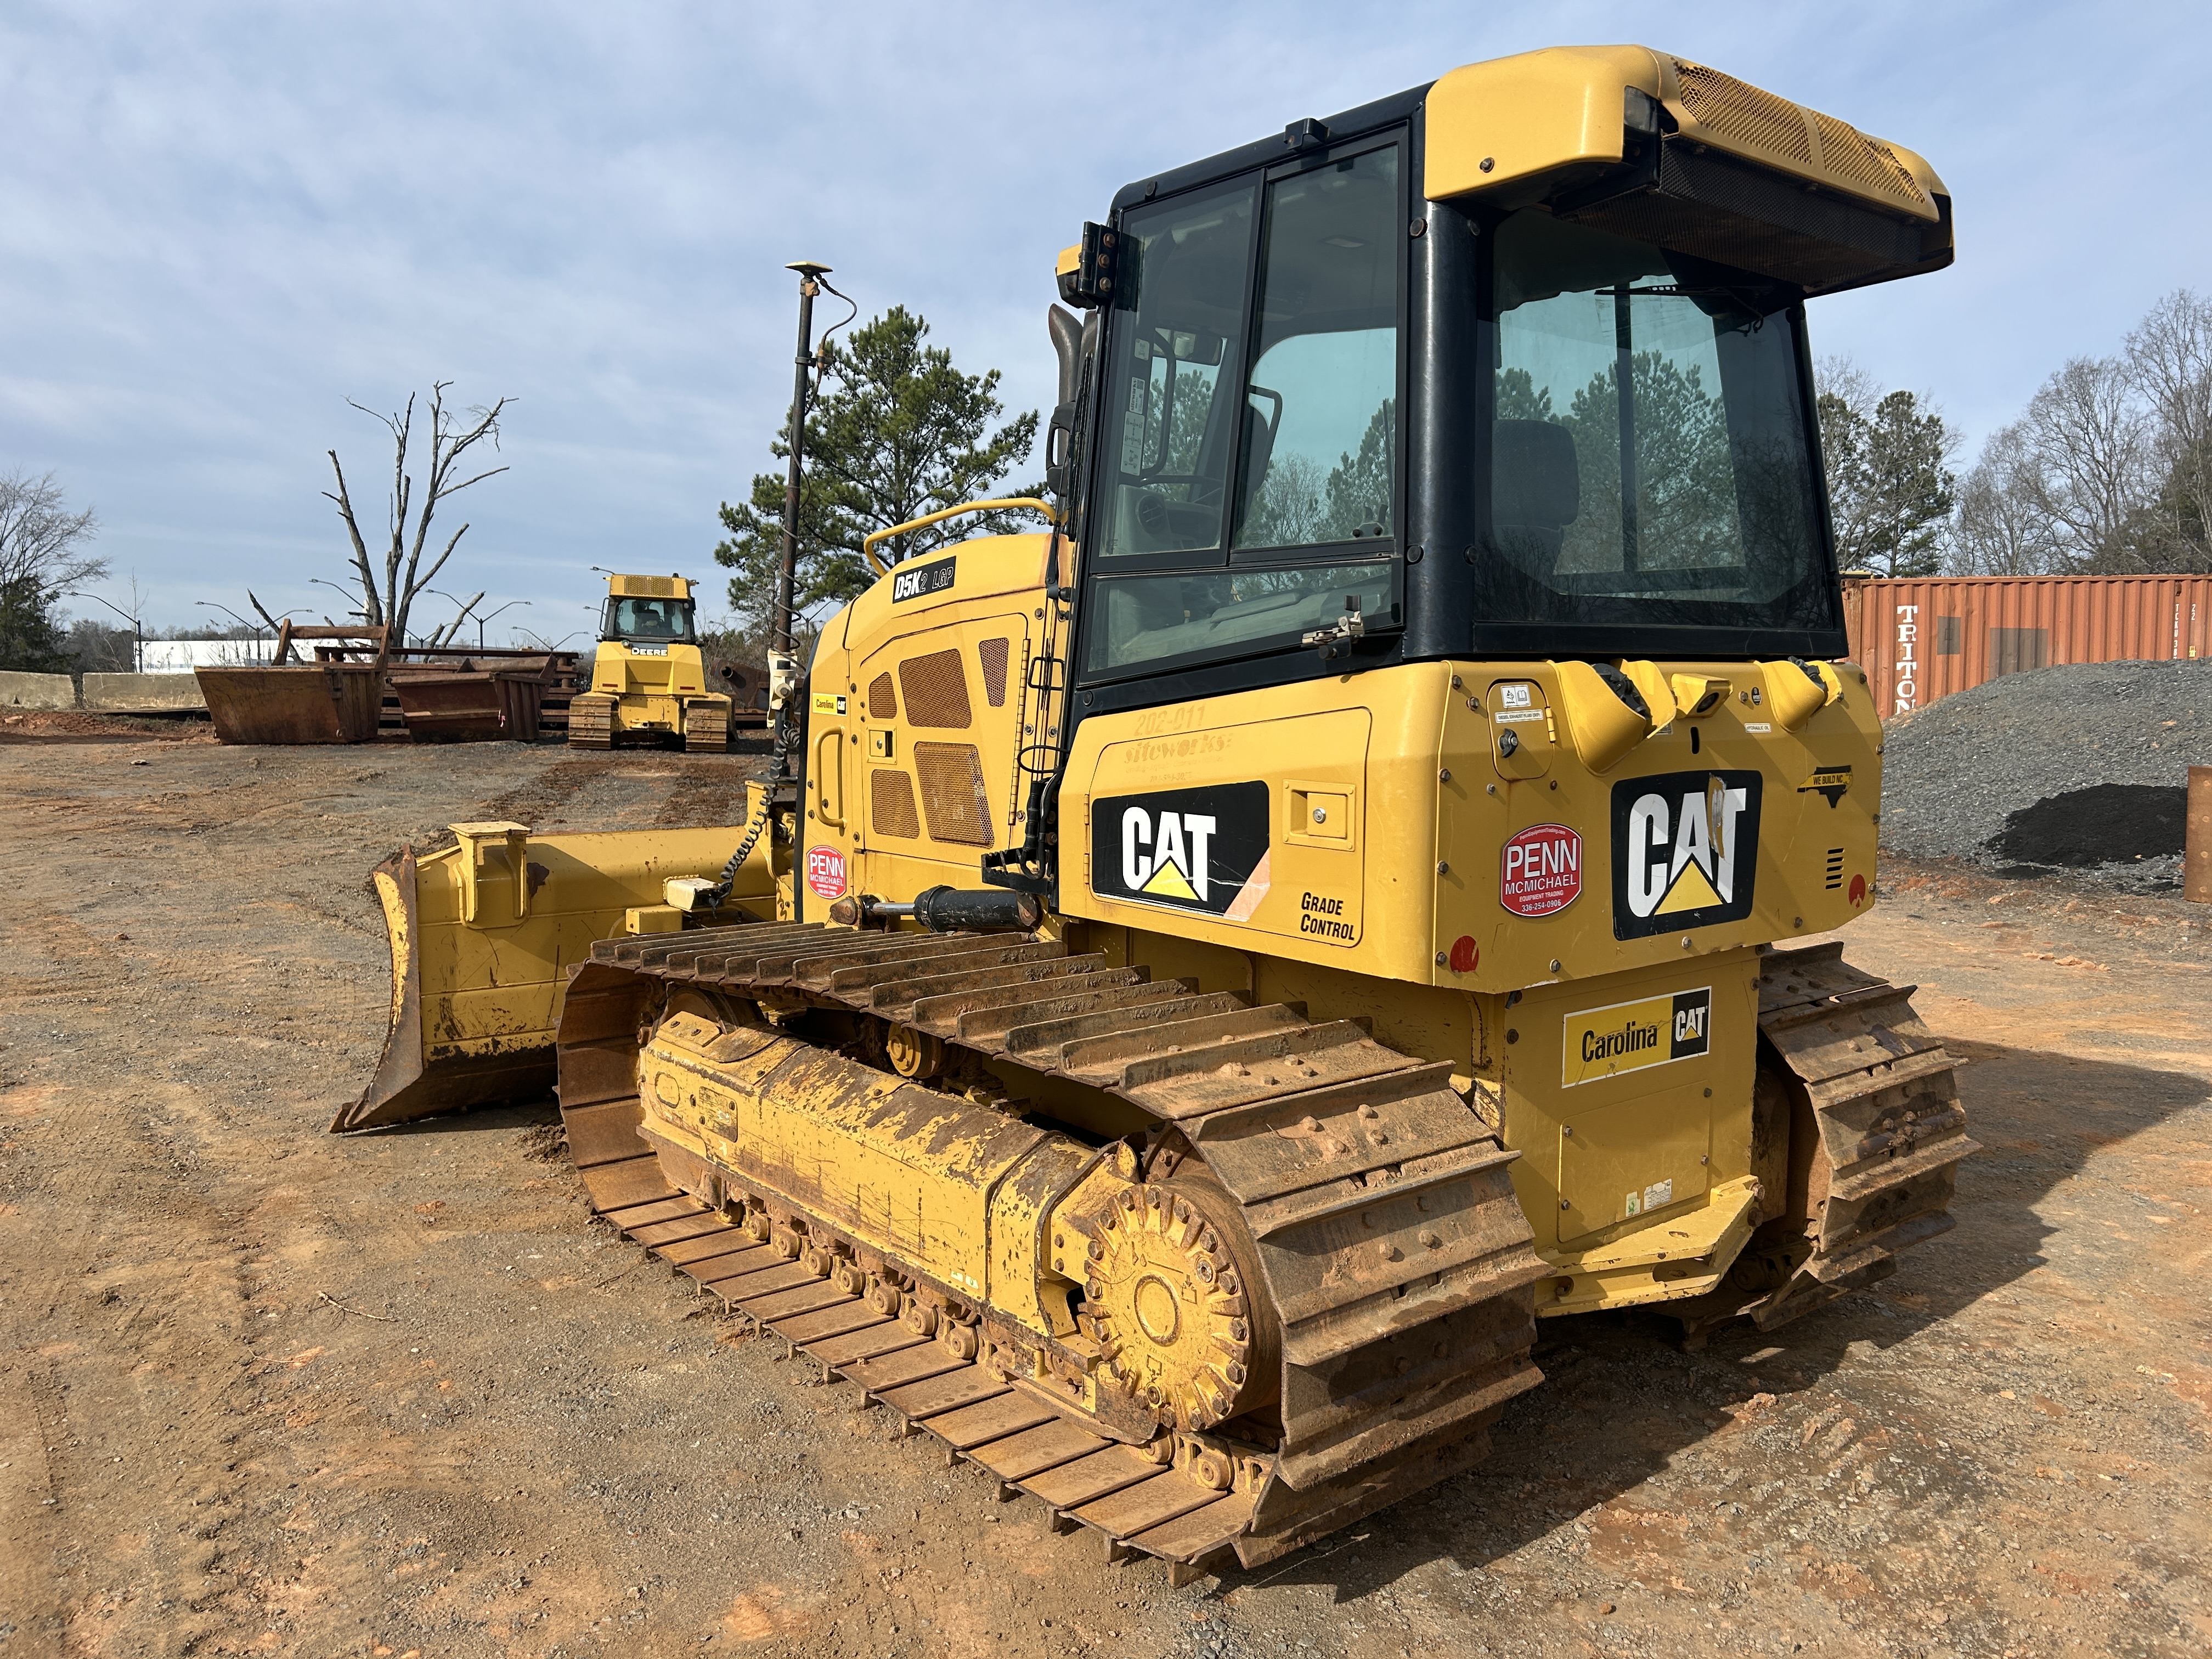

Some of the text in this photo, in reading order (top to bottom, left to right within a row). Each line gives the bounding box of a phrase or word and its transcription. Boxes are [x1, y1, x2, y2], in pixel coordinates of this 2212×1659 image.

[932, 567, 953, 589] LGP
[631, 647, 668, 656] DEERE
[1895, 605, 1918, 715] TRITON
[816, 699, 833, 709] Carolina
[1135, 705, 1205, 736] 202-011
[1124, 734, 1225, 764] siteworks
[1813, 775, 1843, 785] WE BUILD NC
[1122, 806, 1216, 901] CAT
[1506, 838, 1577, 881] PENN
[1628, 788, 1746, 917] CAT
[810, 853, 844, 878] PENN
[810, 873, 844, 887] MCMICHAEL
[1505, 873, 1577, 895] MCMICHAEL
[1519, 889, 1564, 902] EQUIPMENT TRADING
[1521, 899, 1561, 912] 336-254-0906
[1582, 1006, 1706, 1062] Carolina CAT
